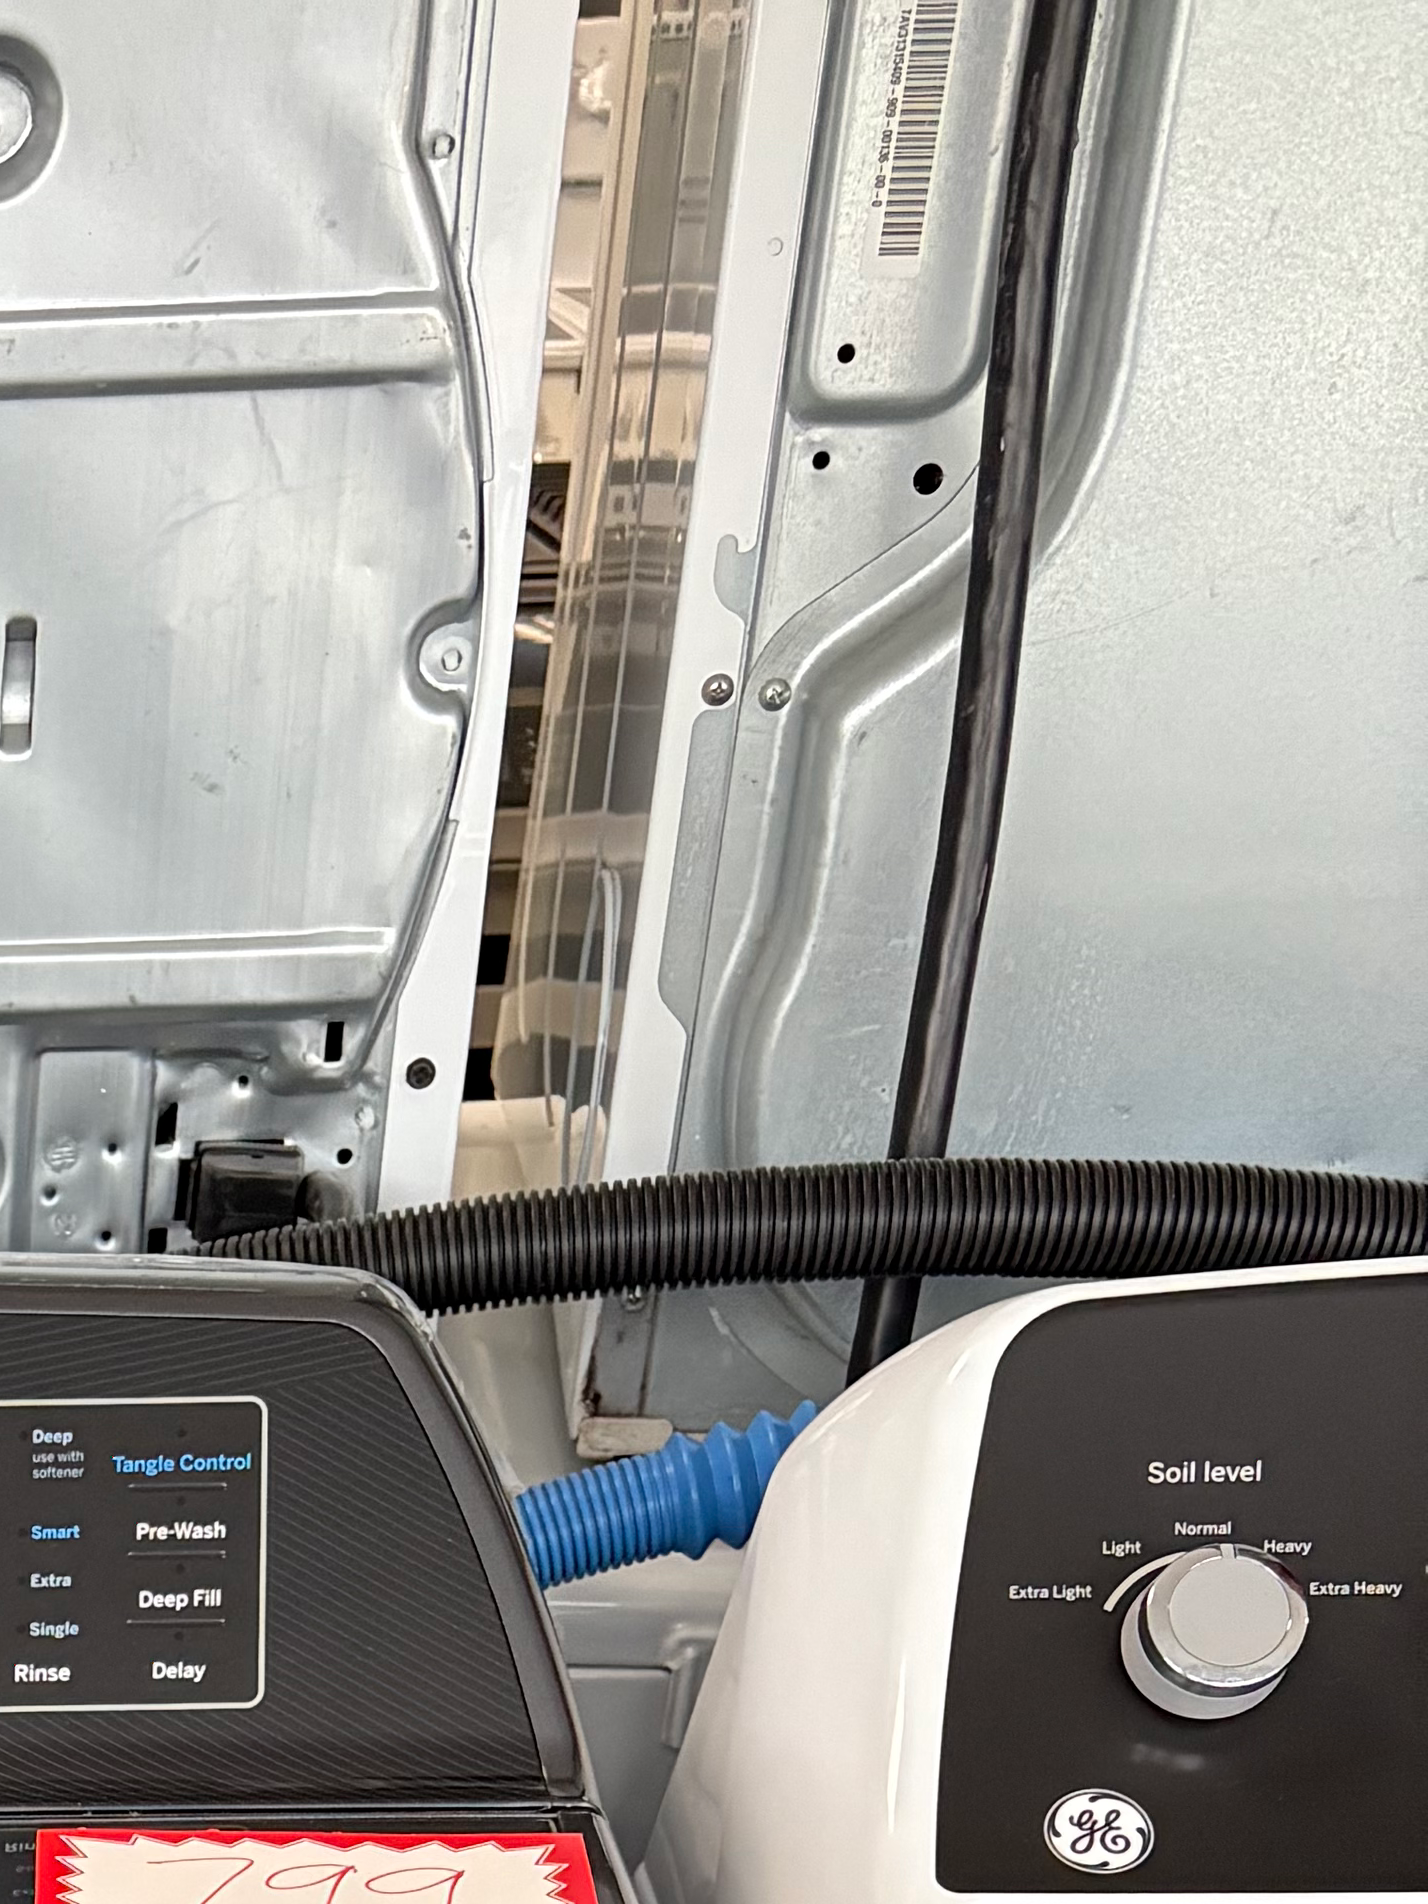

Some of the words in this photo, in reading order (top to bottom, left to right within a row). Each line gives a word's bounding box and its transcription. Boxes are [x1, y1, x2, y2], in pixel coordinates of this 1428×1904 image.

[32, 1429, 74, 1448] Deep
[32, 1454, 54, 1465] use
[57, 1450, 85, 1465] with
[112, 1454, 176, 1477] Tangle
[179, 1452, 252, 1474] Control
[32, 1464, 85, 1480] softener
[1147, 1461, 1197, 1485] Soil
[1203, 1460, 1263, 1484] level
[31, 1524, 81, 1541] Smart
[136, 1520, 227, 1542] Pre-Wash
[1174, 1519, 1232, 1537] Normal
[1102, 1539, 1143, 1557] Light
[1263, 1538, 1313, 1557] Heavy
[30, 1572, 72, 1588] Extra
[1008, 1585, 1049, 1601] Extra
[1052, 1584, 1093, 1602] Light
[1309, 1582, 1350, 1597] Extra
[1353, 1581, 1403, 1599] Heavy
[138, 1590, 189, 1612] Deep
[193, 1588, 222, 1608] Fill
[29, 1621, 80, 1641] Single
[13, 1664, 71, 1684] Rinse
[151, 1661, 207, 1684] Delay
